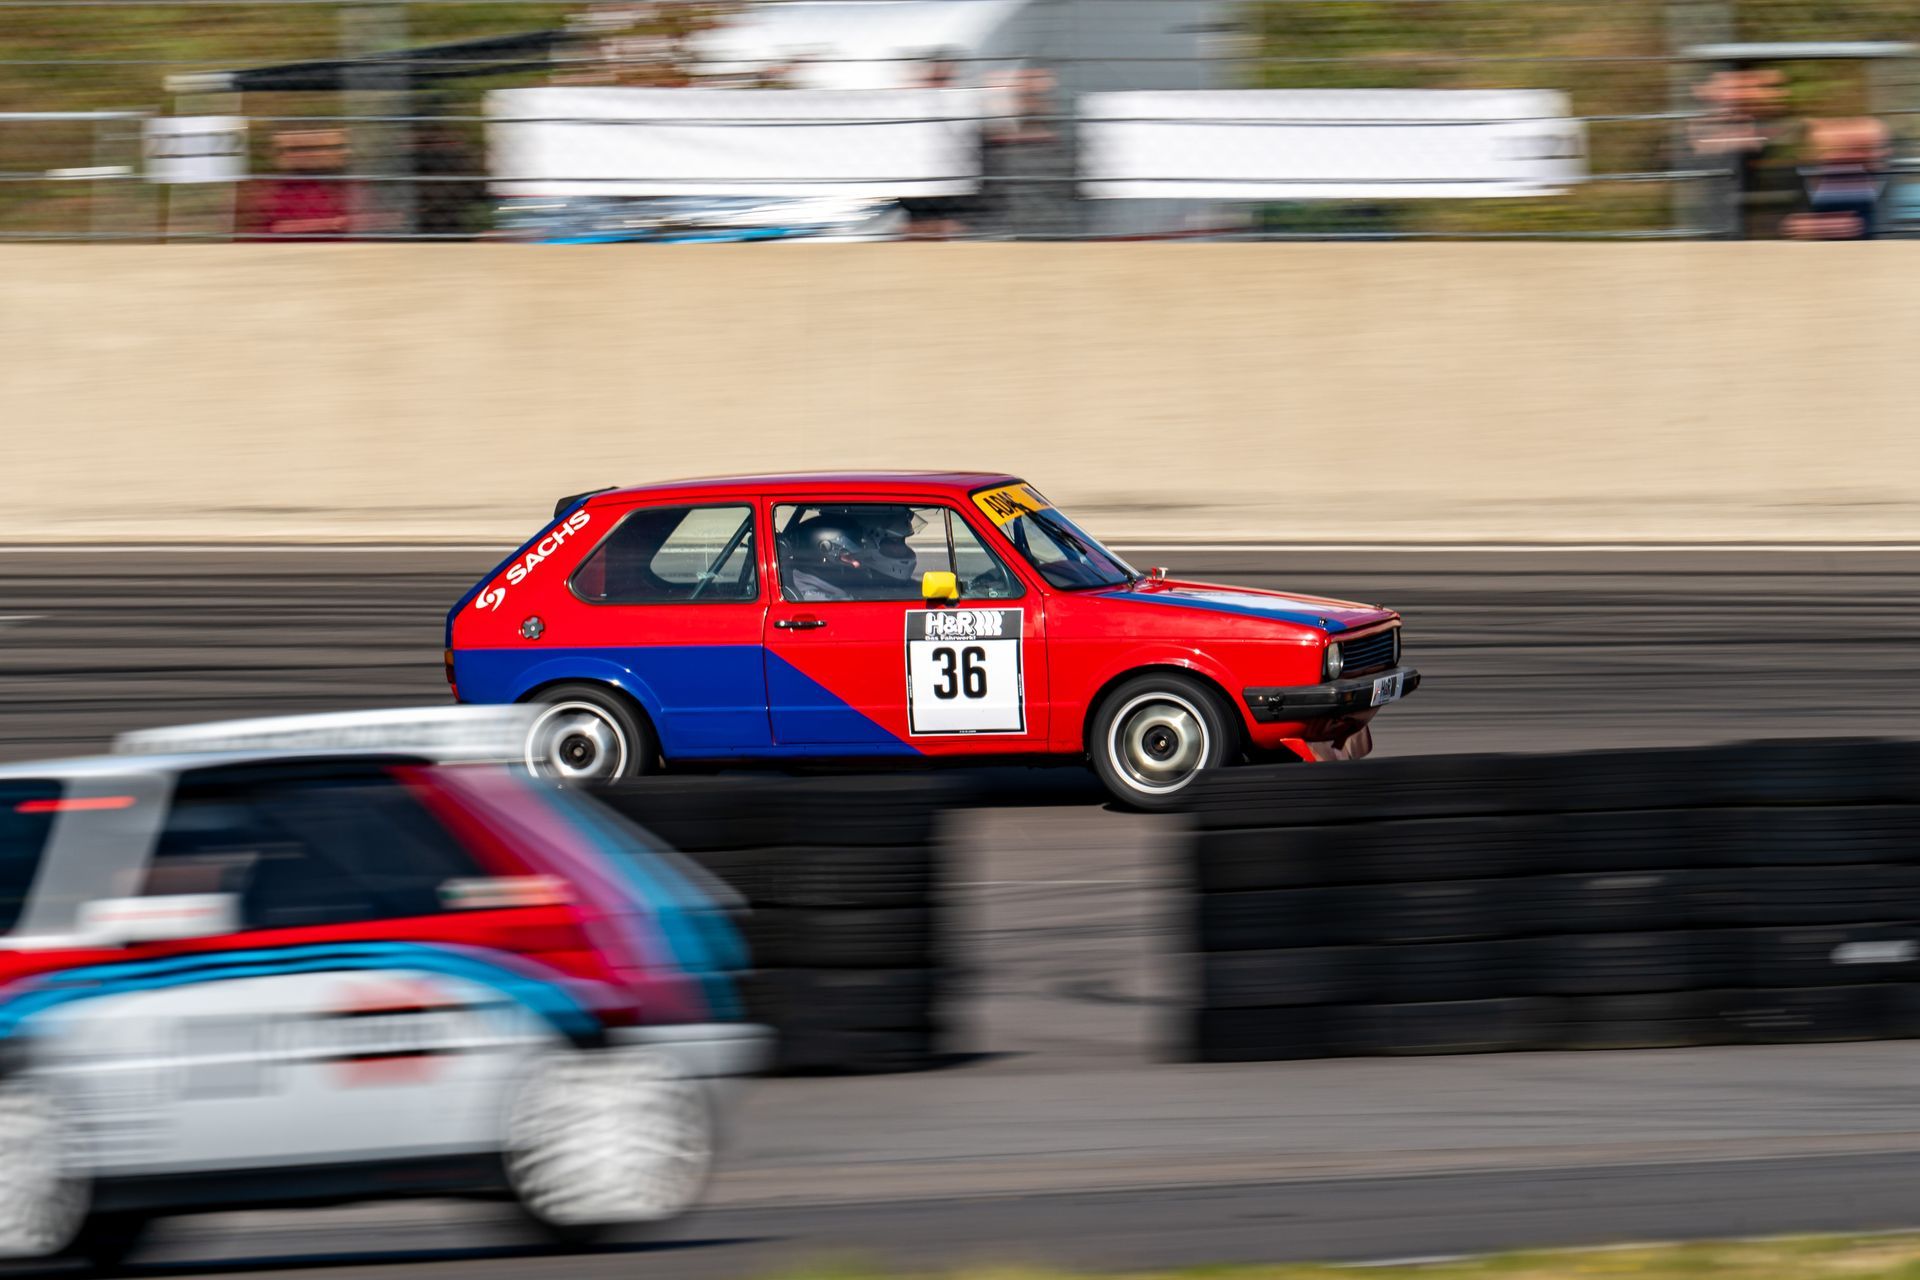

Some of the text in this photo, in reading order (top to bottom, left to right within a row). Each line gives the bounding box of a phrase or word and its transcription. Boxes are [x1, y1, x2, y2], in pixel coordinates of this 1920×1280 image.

[506, 509, 590, 585] SACHS
[925, 611, 977, 636] H&R
[932, 646, 988, 700] 36
